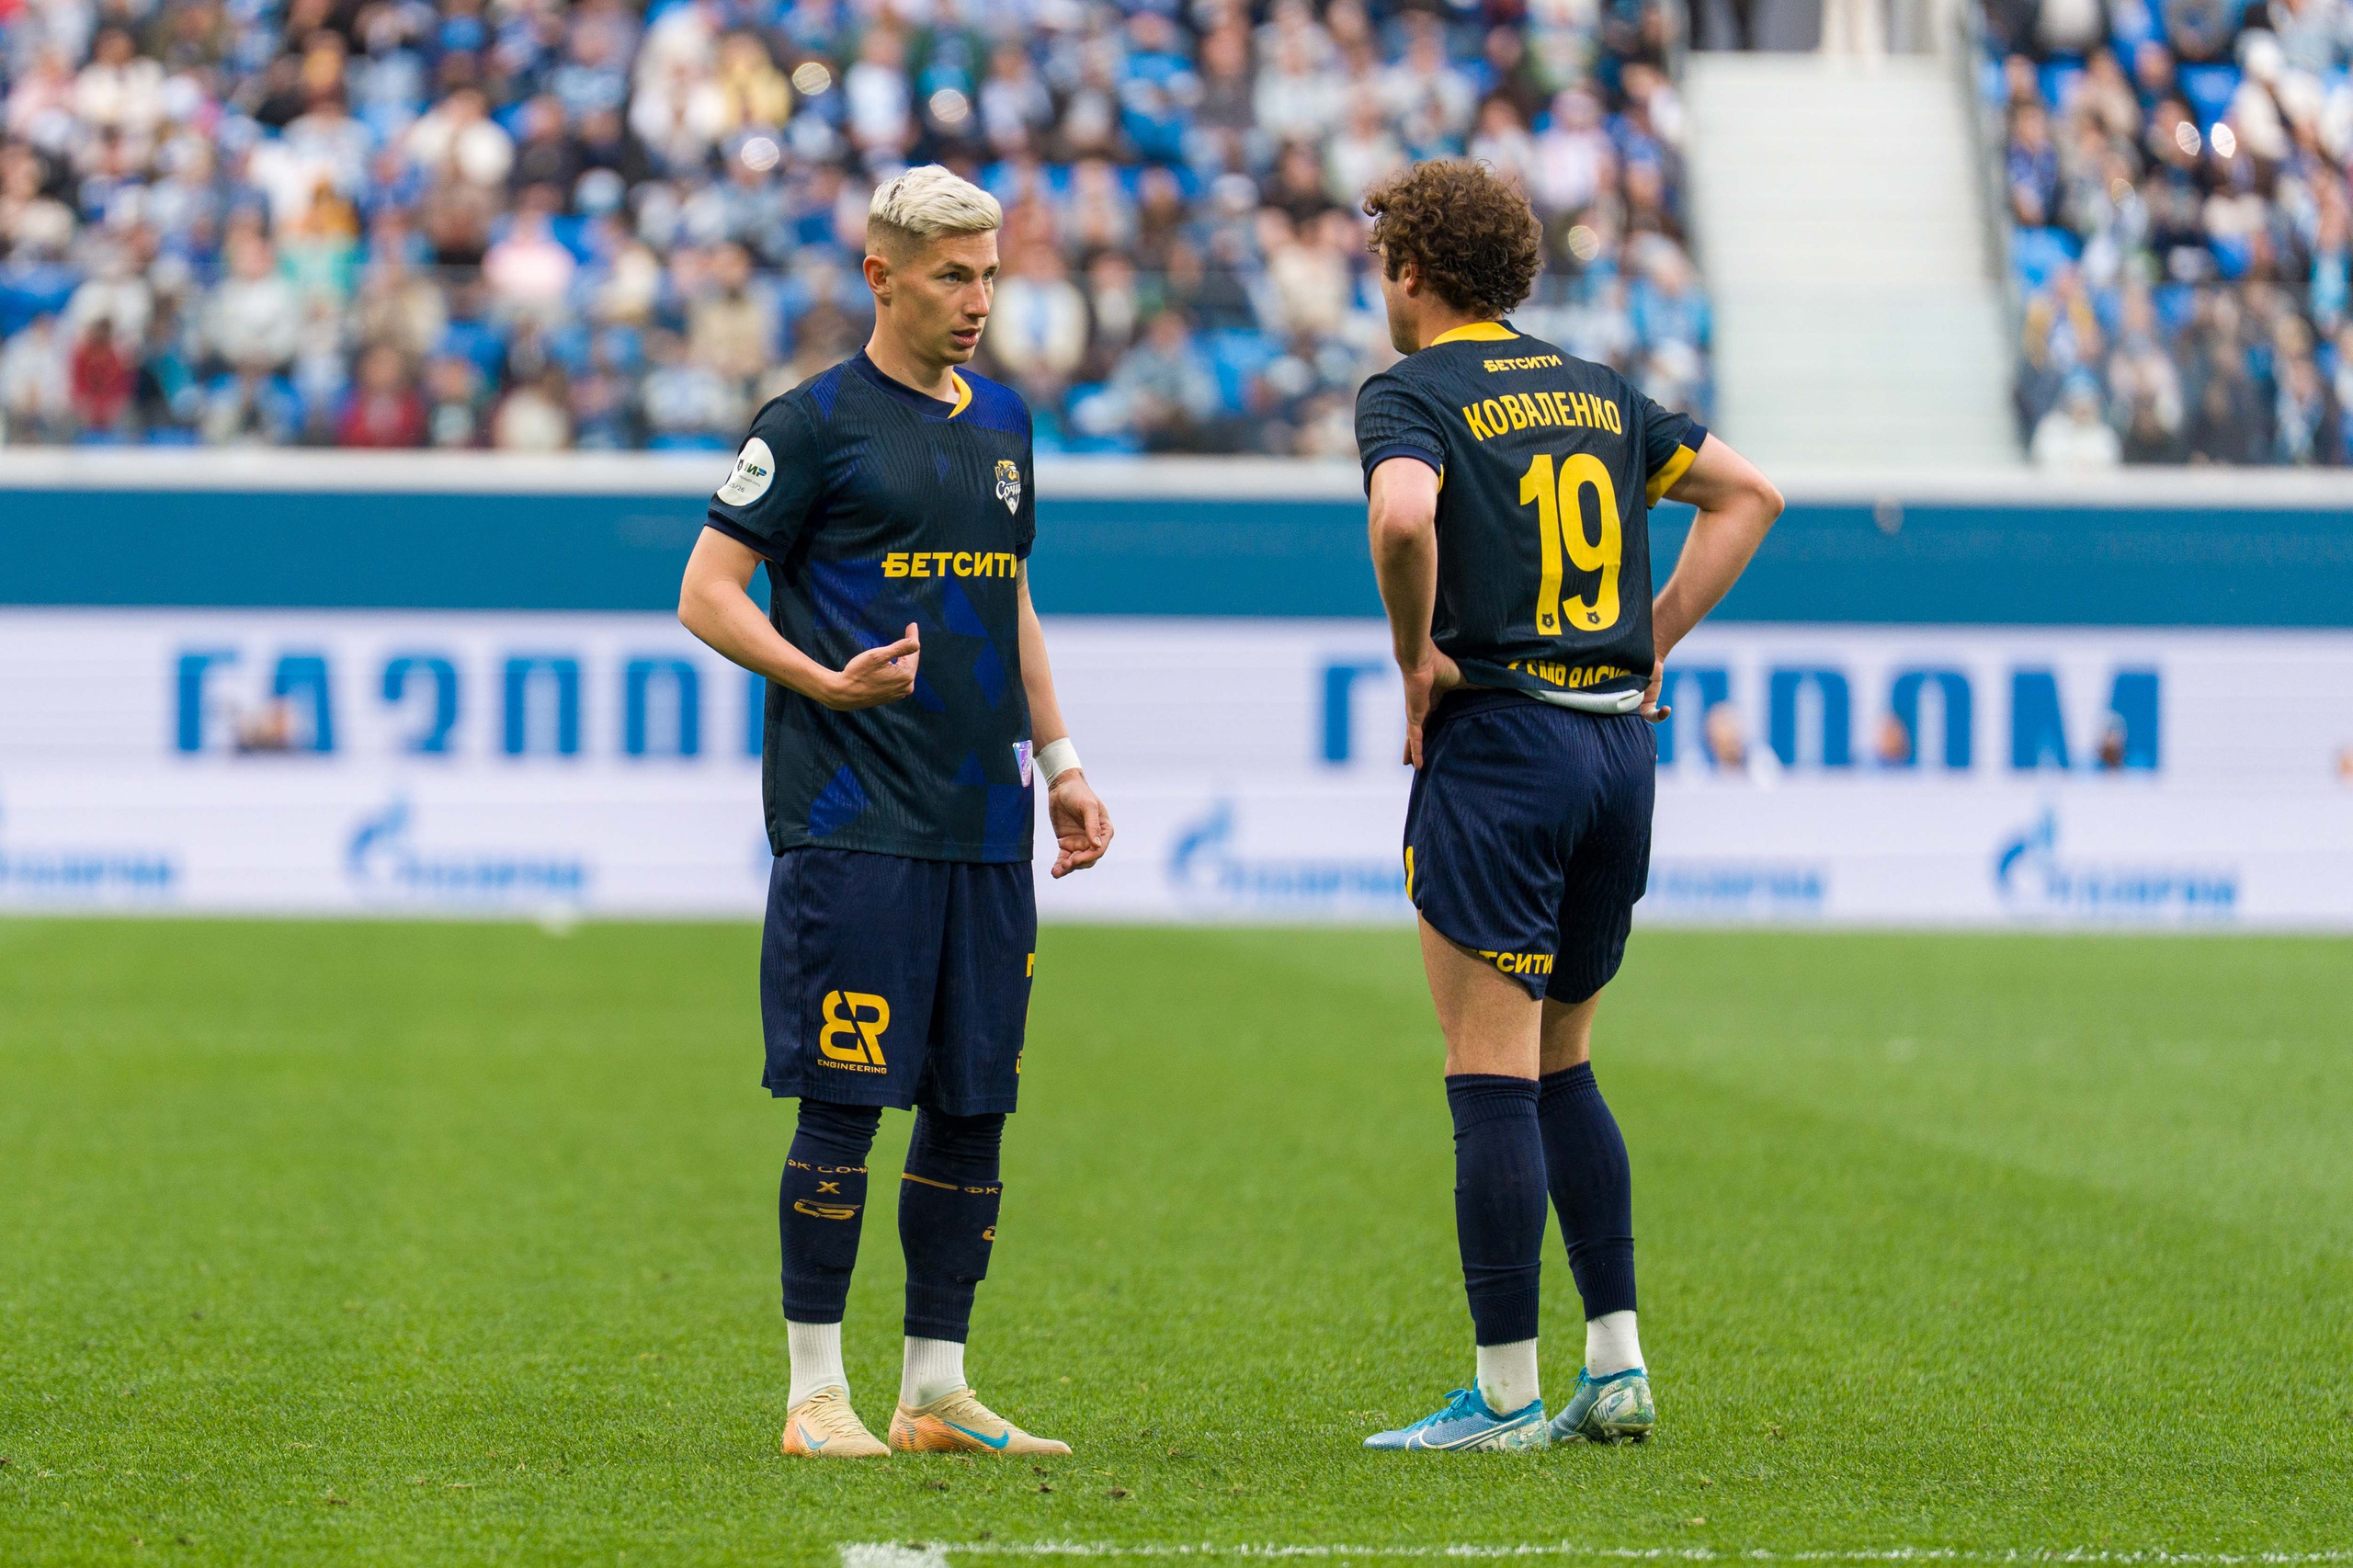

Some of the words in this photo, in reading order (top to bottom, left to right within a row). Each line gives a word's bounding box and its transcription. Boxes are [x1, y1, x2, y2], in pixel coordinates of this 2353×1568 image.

[1483, 355, 1563, 373] БЕТСИТИ
[1461, 392, 1622, 442] КОВАЛЕНКО
[745, 462, 767, 477] ИР
[728, 482, 745, 494] 5/26
[1519, 452, 1622, 636] 19
[817, 1059, 887, 1074] ENGINEERING
